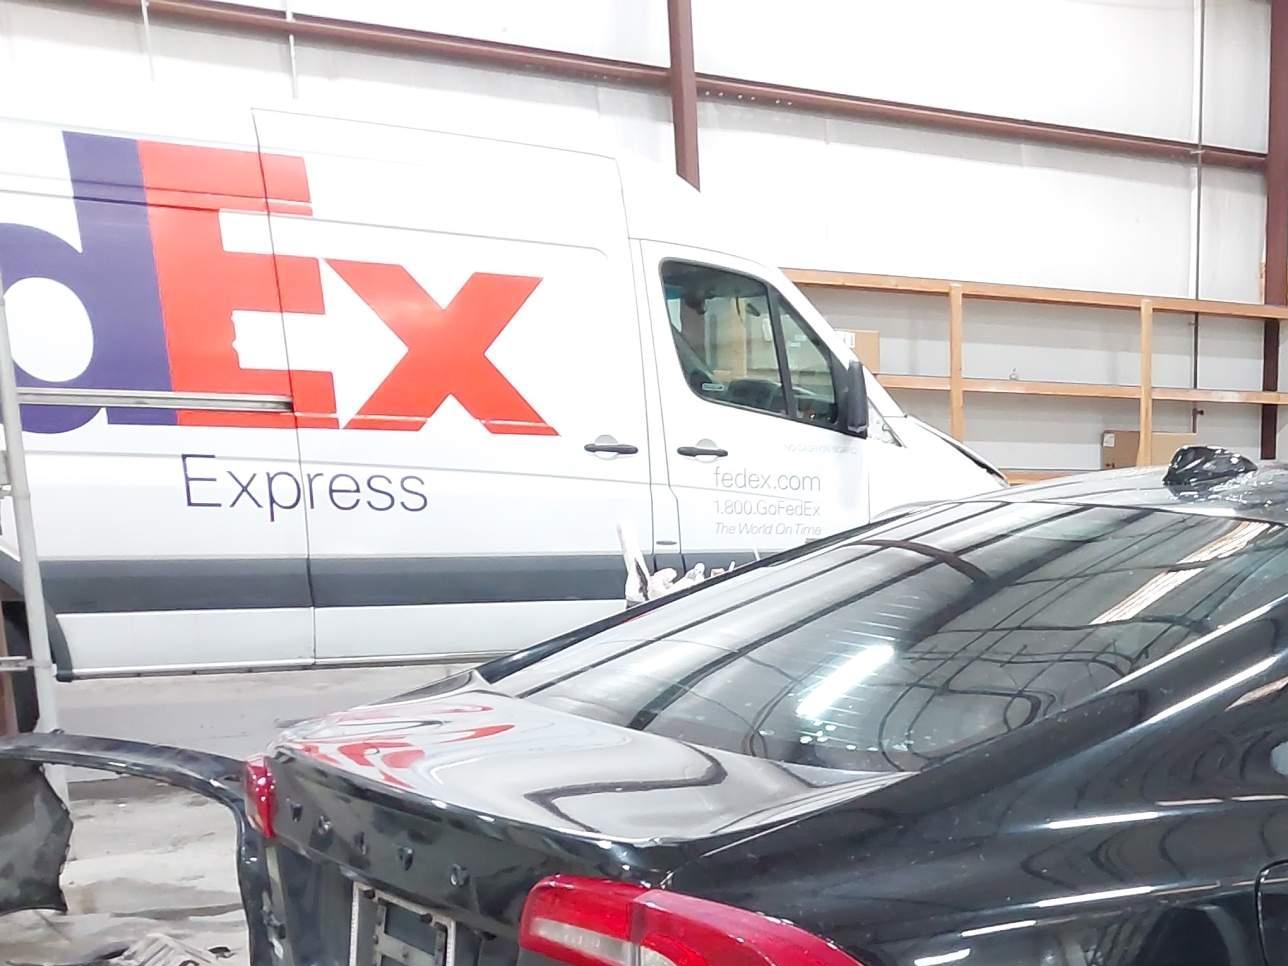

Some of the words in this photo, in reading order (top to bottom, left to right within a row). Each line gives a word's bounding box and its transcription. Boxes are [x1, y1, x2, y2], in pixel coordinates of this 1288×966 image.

[181, 453, 429, 522] Express
[713, 466, 821, 491] fedex.com
[714, 499, 821, 517] 1.800.GoFedEx
[715, 521, 736, 535] The
[738, 522, 773, 536] World
[775, 523, 792, 536] On
[794, 523, 822, 537] Time
